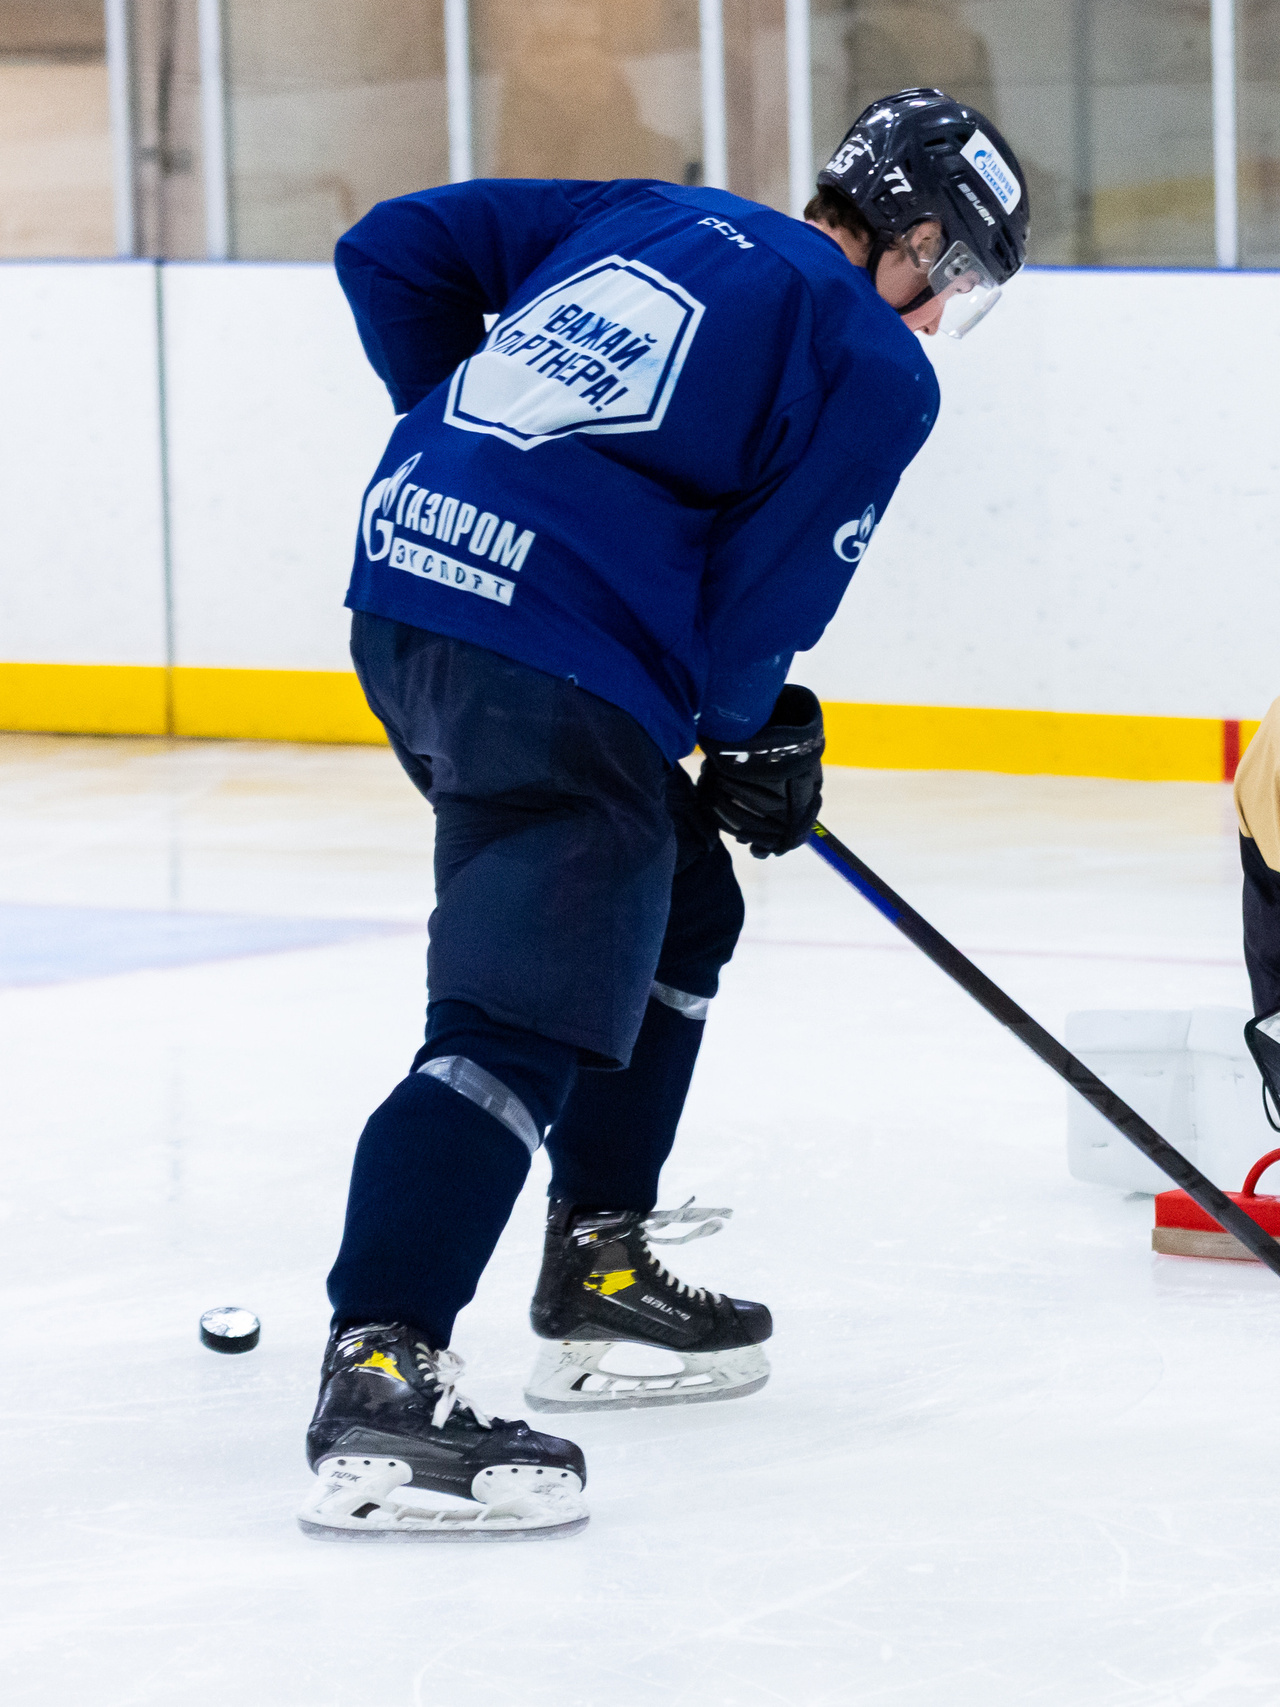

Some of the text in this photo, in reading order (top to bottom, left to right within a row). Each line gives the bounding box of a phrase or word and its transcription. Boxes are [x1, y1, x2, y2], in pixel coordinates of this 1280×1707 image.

[826, 144, 865, 175] 55
[883, 166, 912, 195] 77
[543, 303, 658, 371] ВАЖАЙ
[396, 482, 536, 573] ГАЗПРОМ
